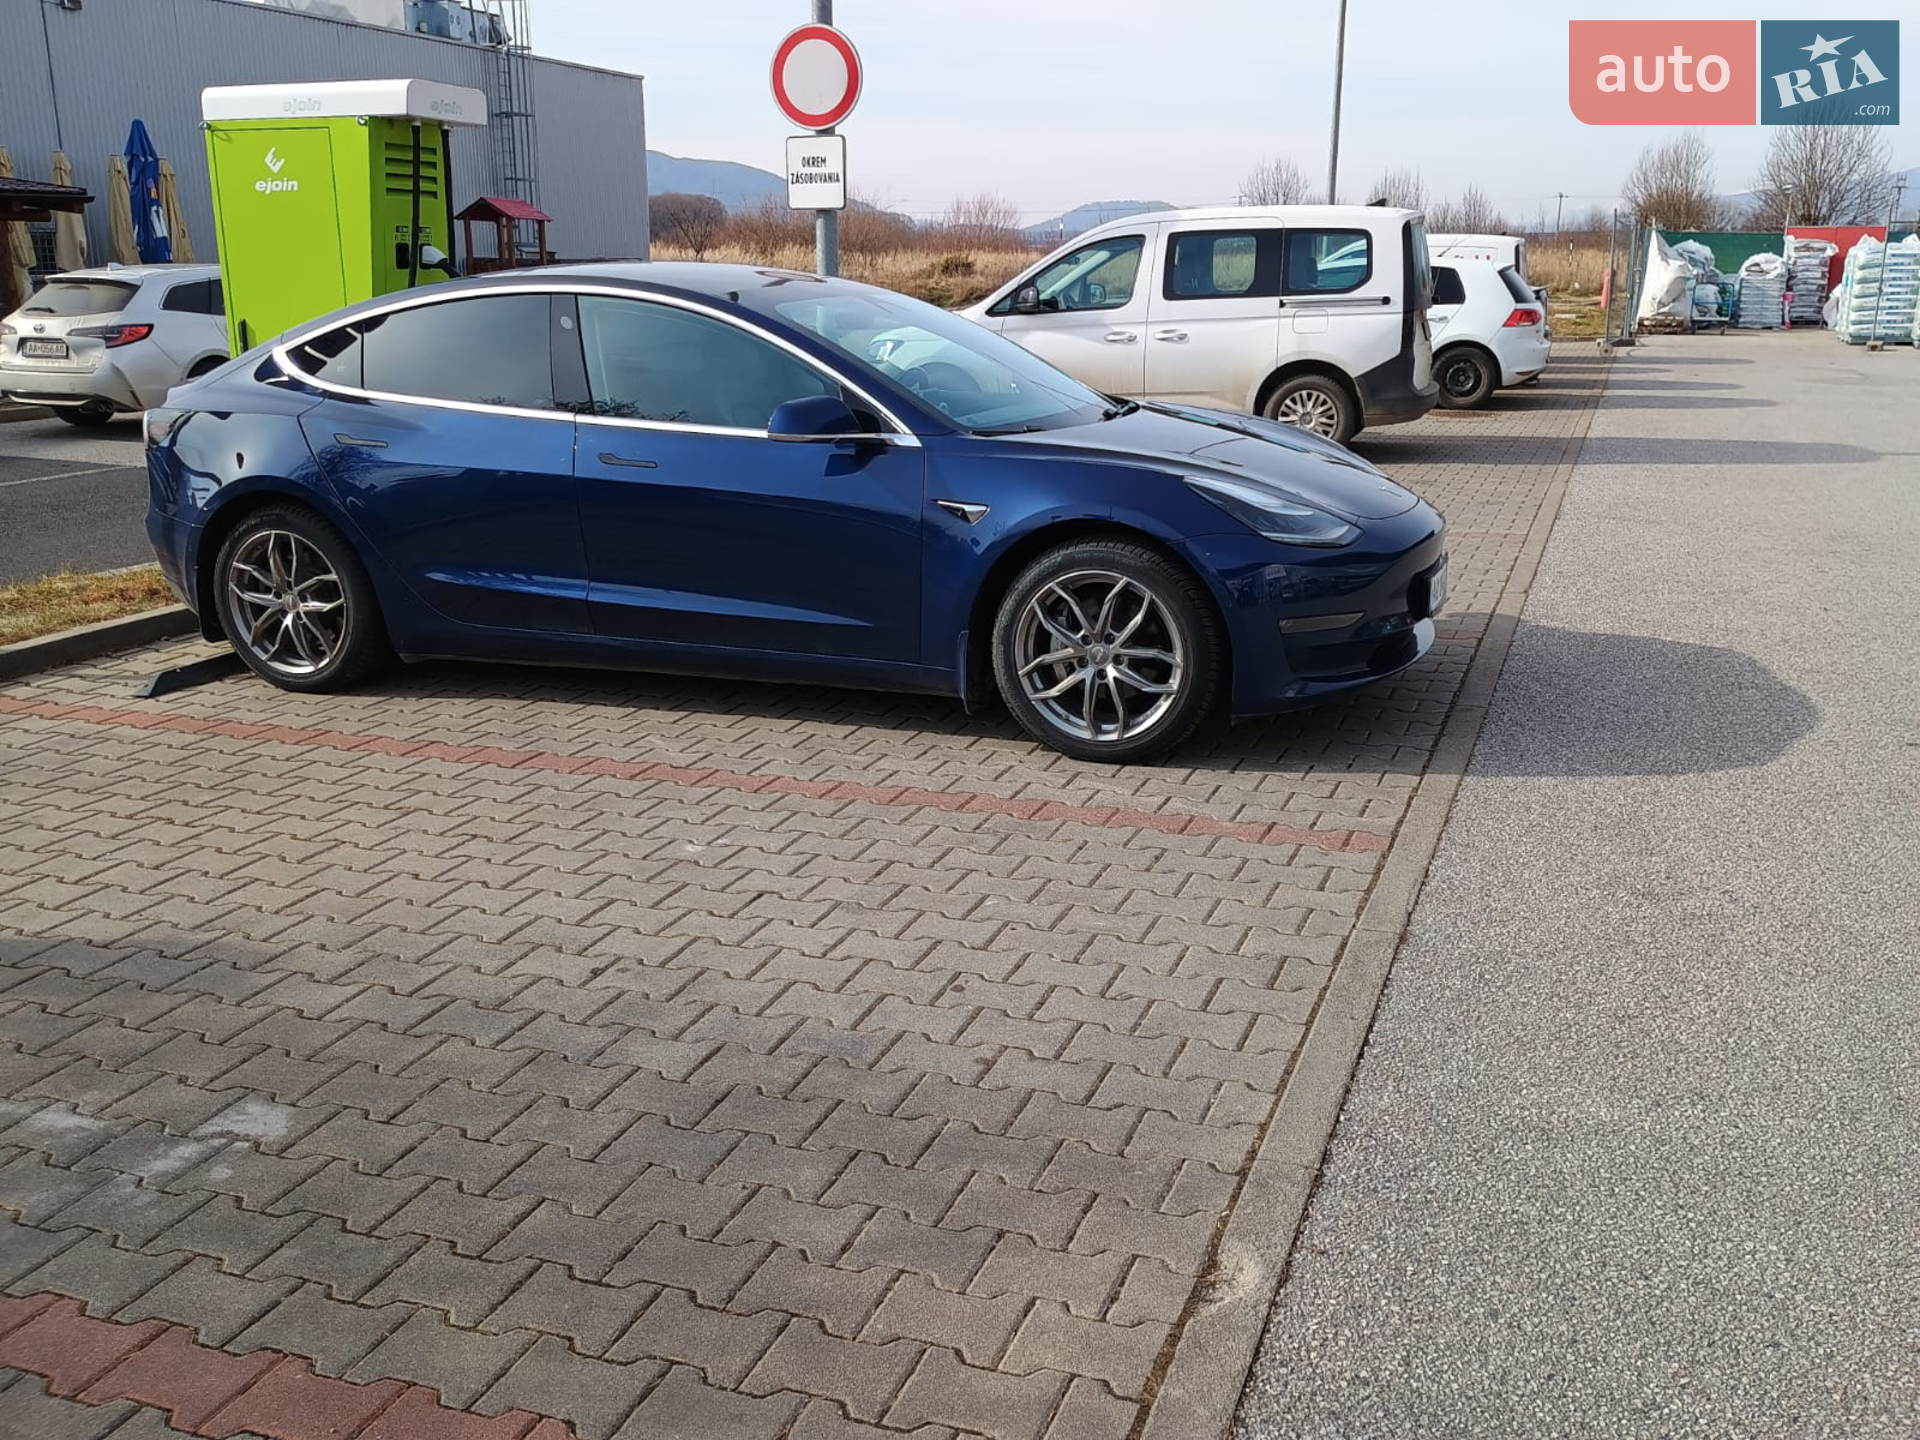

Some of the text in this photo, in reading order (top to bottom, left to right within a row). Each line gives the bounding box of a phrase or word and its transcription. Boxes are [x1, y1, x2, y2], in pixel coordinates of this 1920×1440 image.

[282, 97, 322, 115] ejoin
[430, 99, 462, 116] ejoin
[801, 156, 827, 168] OKREM
[255, 177, 299, 194] ejoin
[790, 171, 841, 185] ZÁSOBOVANIA
